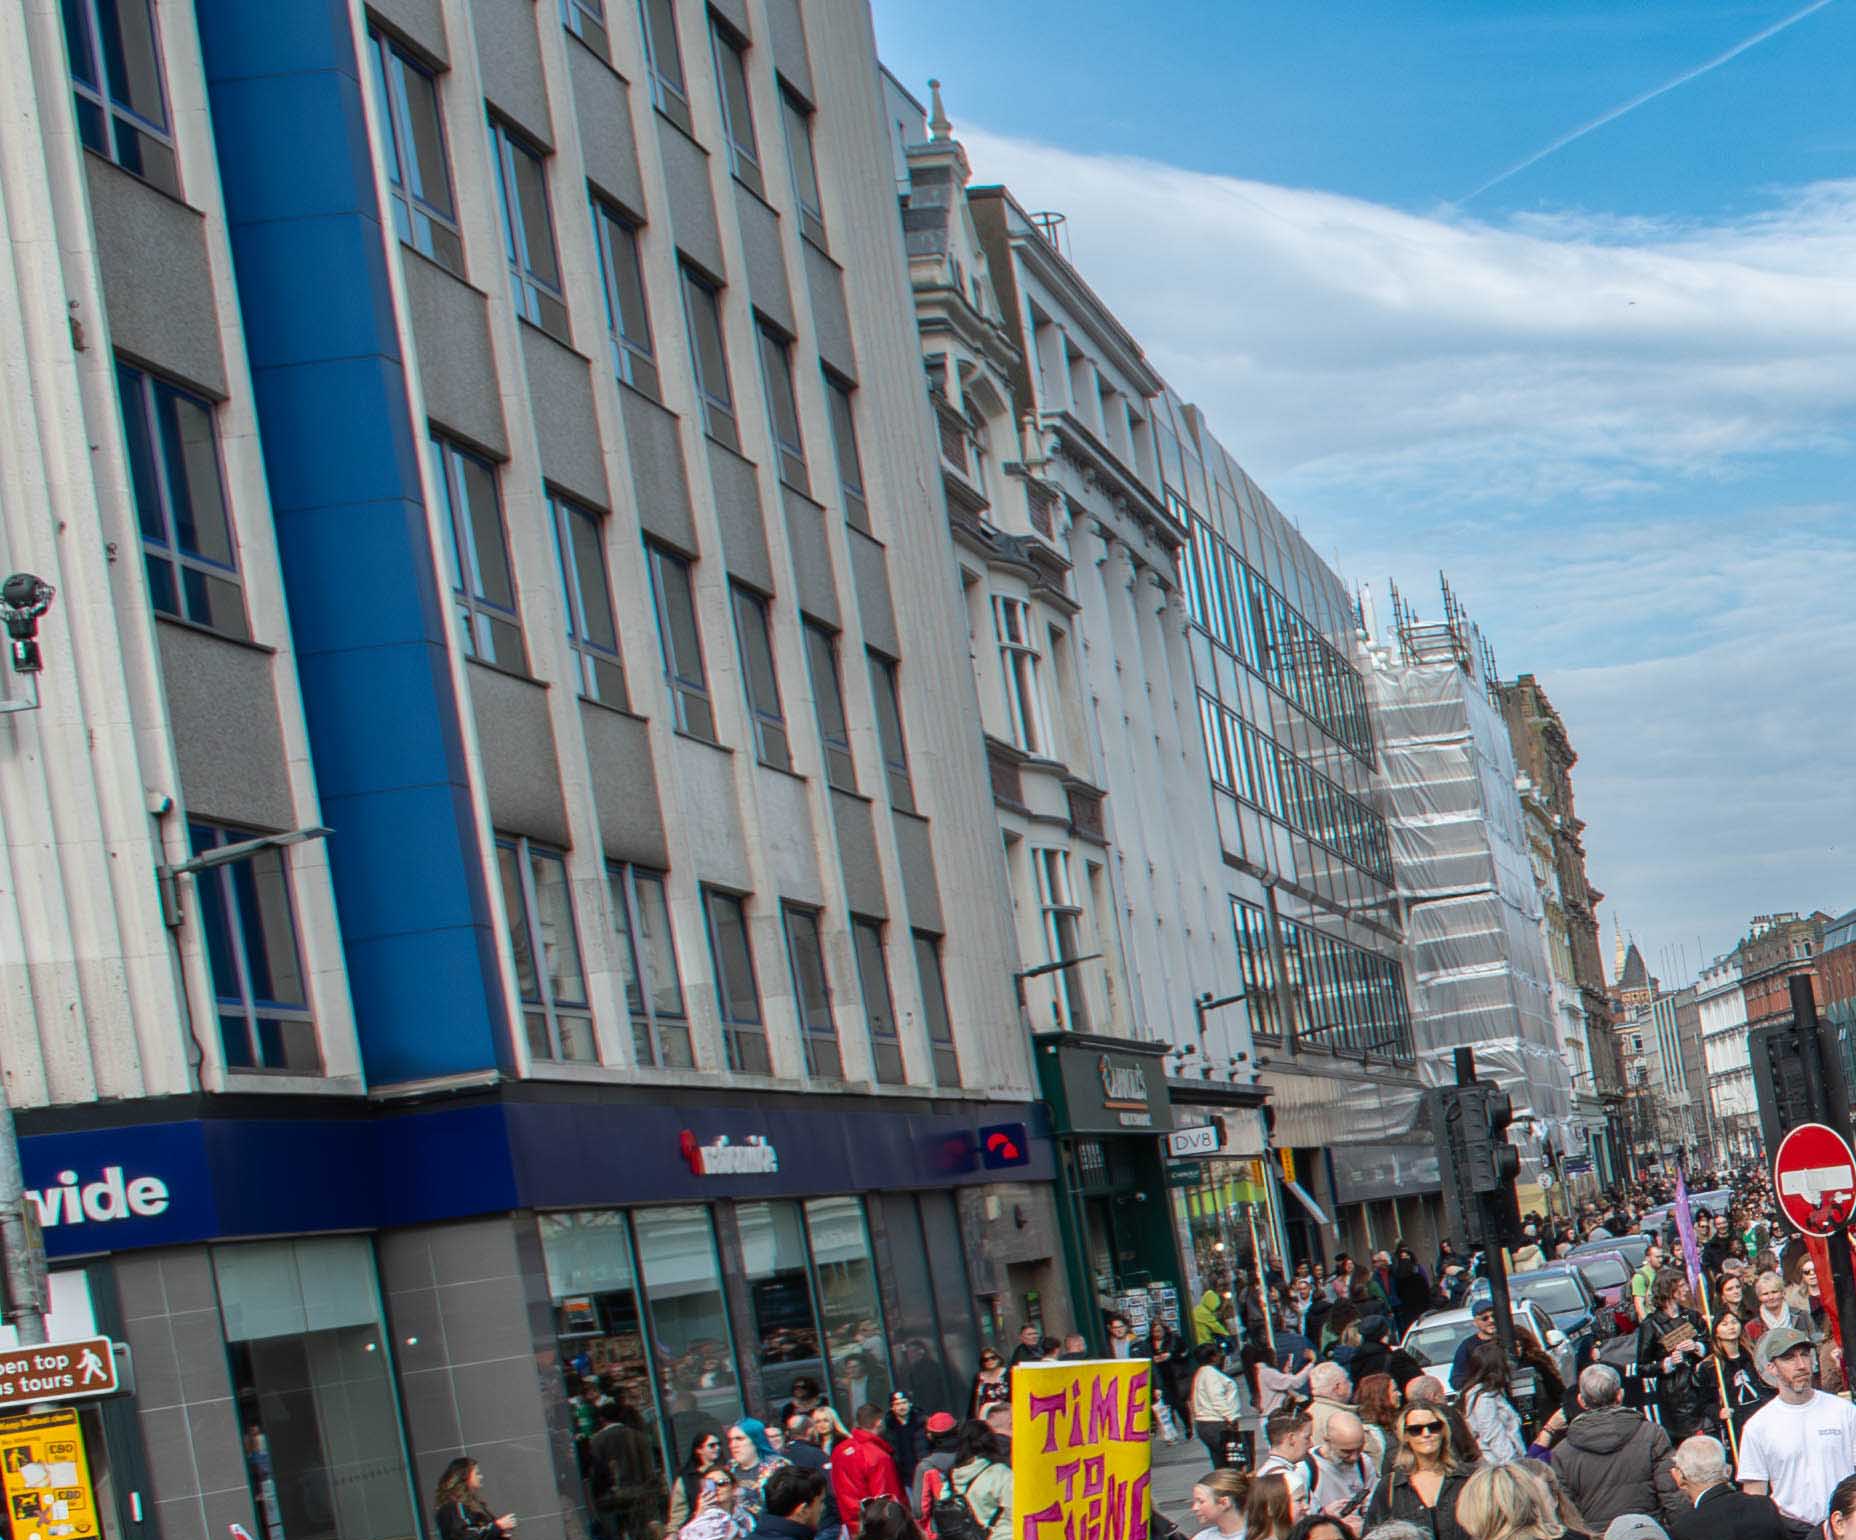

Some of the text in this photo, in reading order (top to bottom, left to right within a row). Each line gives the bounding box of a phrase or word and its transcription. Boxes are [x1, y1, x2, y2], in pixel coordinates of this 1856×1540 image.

[1174, 1132, 1213, 1151] DV8
[34, 1353, 70, 1371] top
[19, 1373, 74, 1392] tours
[1055, 1453, 1106, 1504] TO
